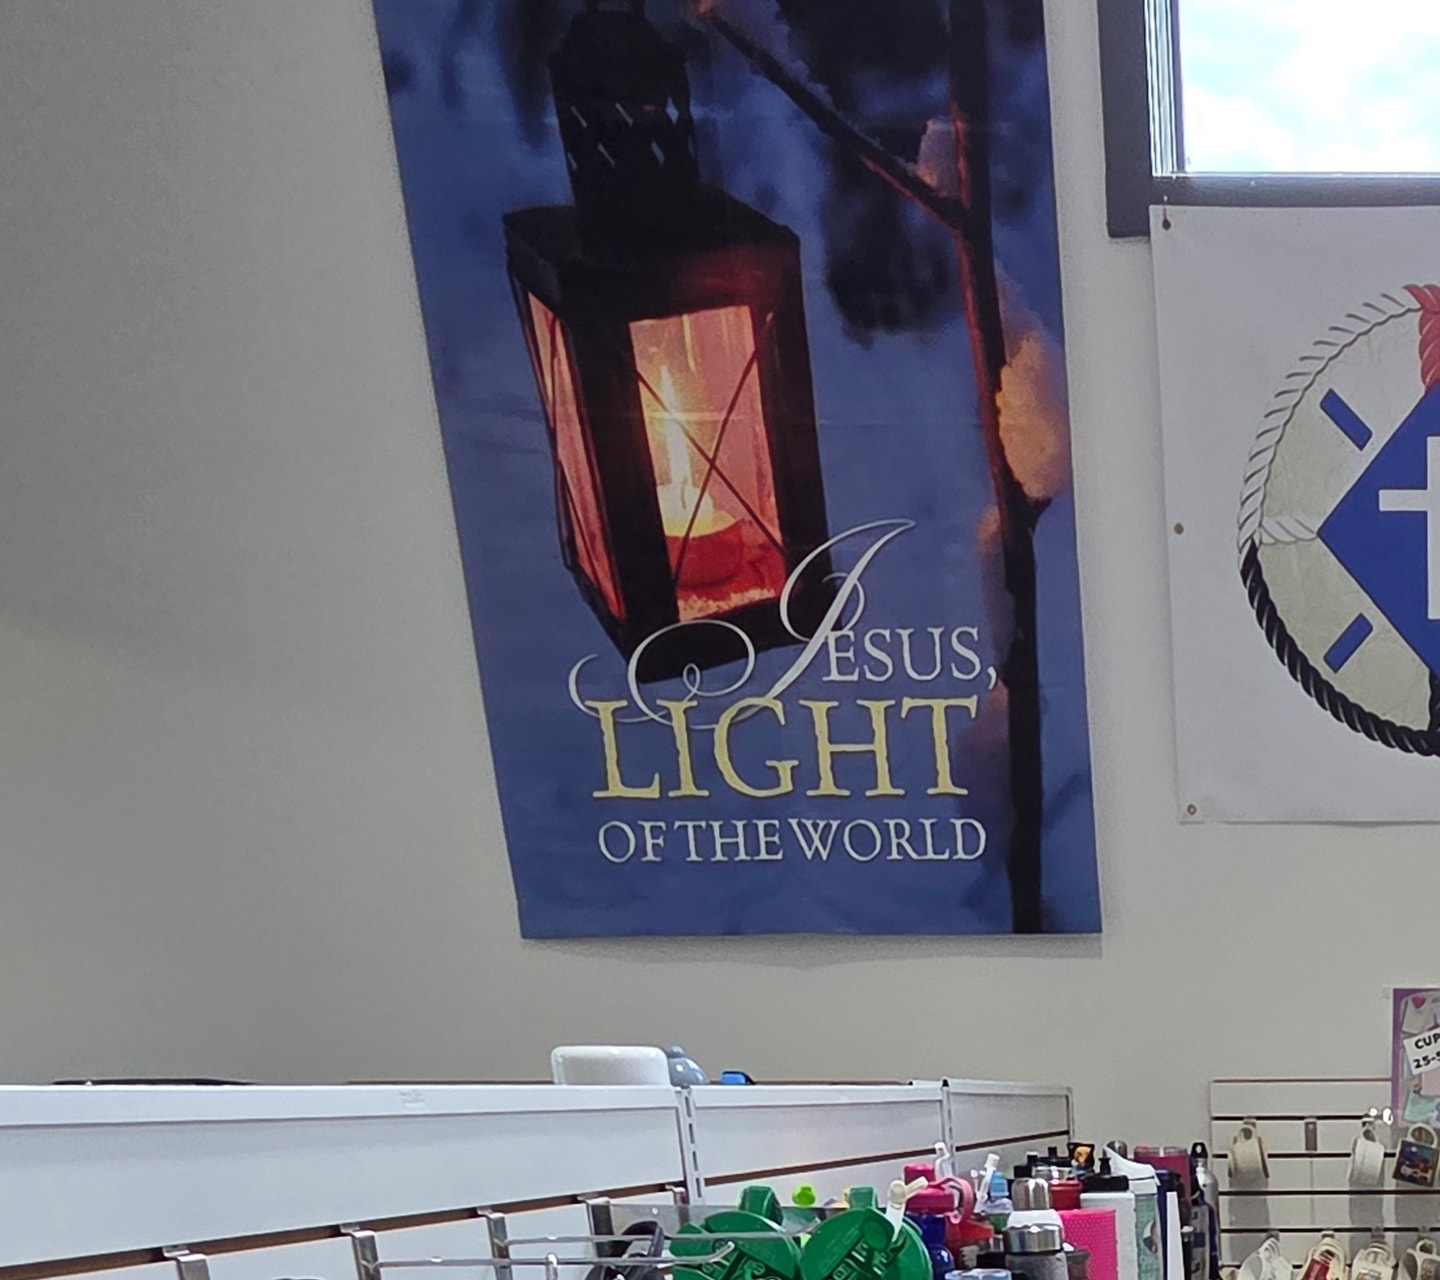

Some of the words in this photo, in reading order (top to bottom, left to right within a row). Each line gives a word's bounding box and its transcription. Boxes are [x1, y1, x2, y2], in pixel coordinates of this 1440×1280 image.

[584, 694, 977, 799] LIGHT
[599, 820, 665, 863] OF
[673, 819, 784, 862] THE
[787, 818, 986, 862] WORLD
